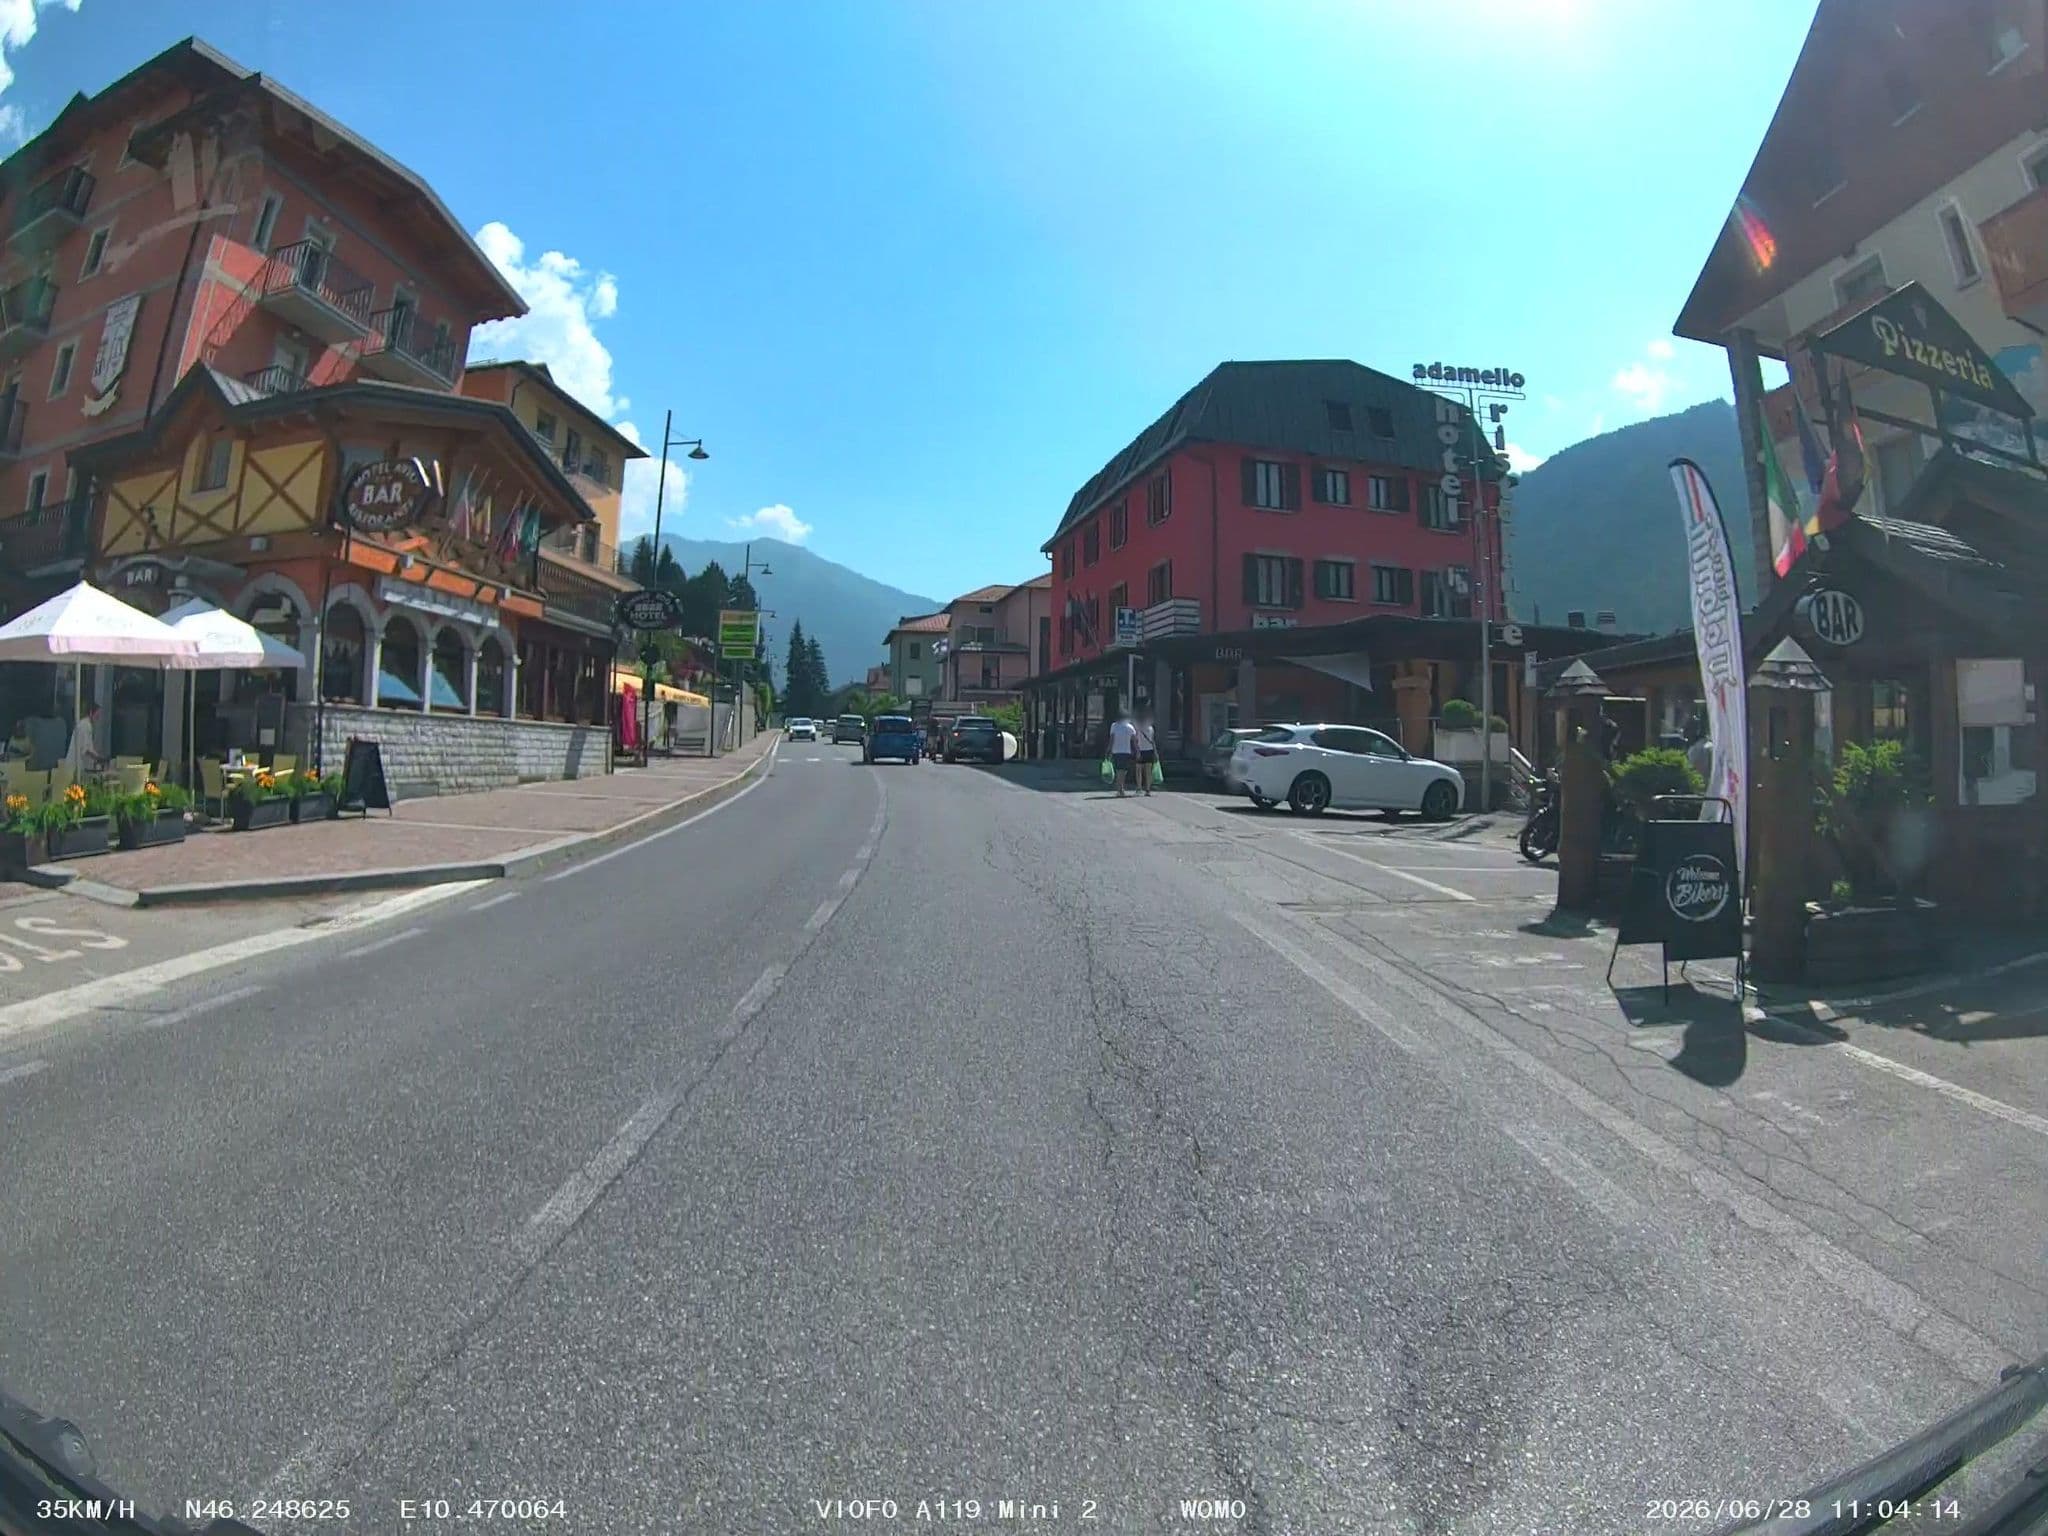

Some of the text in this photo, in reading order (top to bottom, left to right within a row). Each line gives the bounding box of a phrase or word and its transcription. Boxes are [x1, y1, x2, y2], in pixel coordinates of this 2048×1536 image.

[1872, 315, 1994, 391] Pizzeria
[1413, 361, 1526, 388] adamello
[1435, 399, 1462, 523] hotel
[362, 481, 403, 505] BAR
[127, 568, 153, 585] BAR
[630, 610, 668, 620] HOTEL
[1816, 593, 1860, 641] BAR
